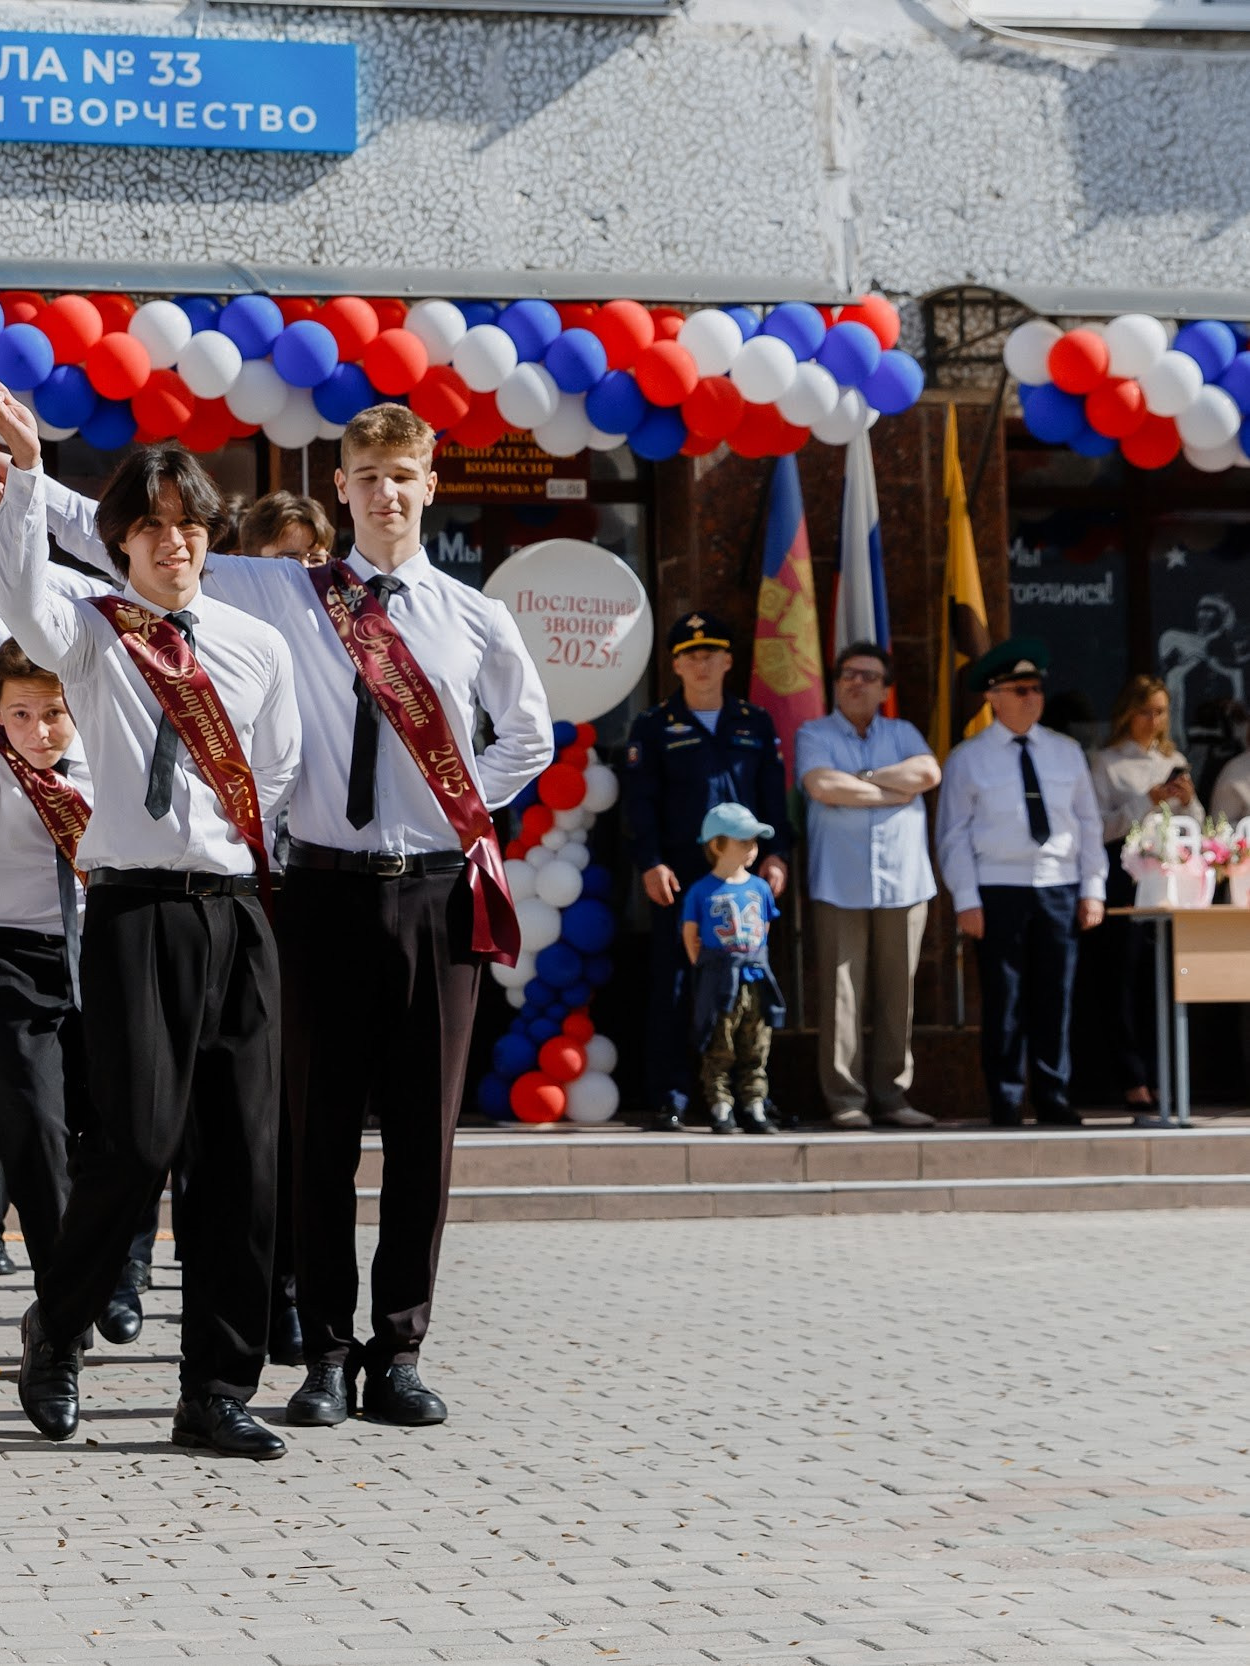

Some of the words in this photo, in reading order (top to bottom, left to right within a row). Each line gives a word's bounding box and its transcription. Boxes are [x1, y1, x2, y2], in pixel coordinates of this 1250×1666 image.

[82, 48, 136, 85] №
[148, 51, 203, 87] 33
[21, 95, 317, 133] ТВОРЧЕСТВО
[516, 589, 637, 617] Последний
[542, 614, 618, 637] звонок
[353, 612, 430, 729] Выпускник
[154, 644, 226, 762] Выпускник
[427, 743, 470, 797] 2025
